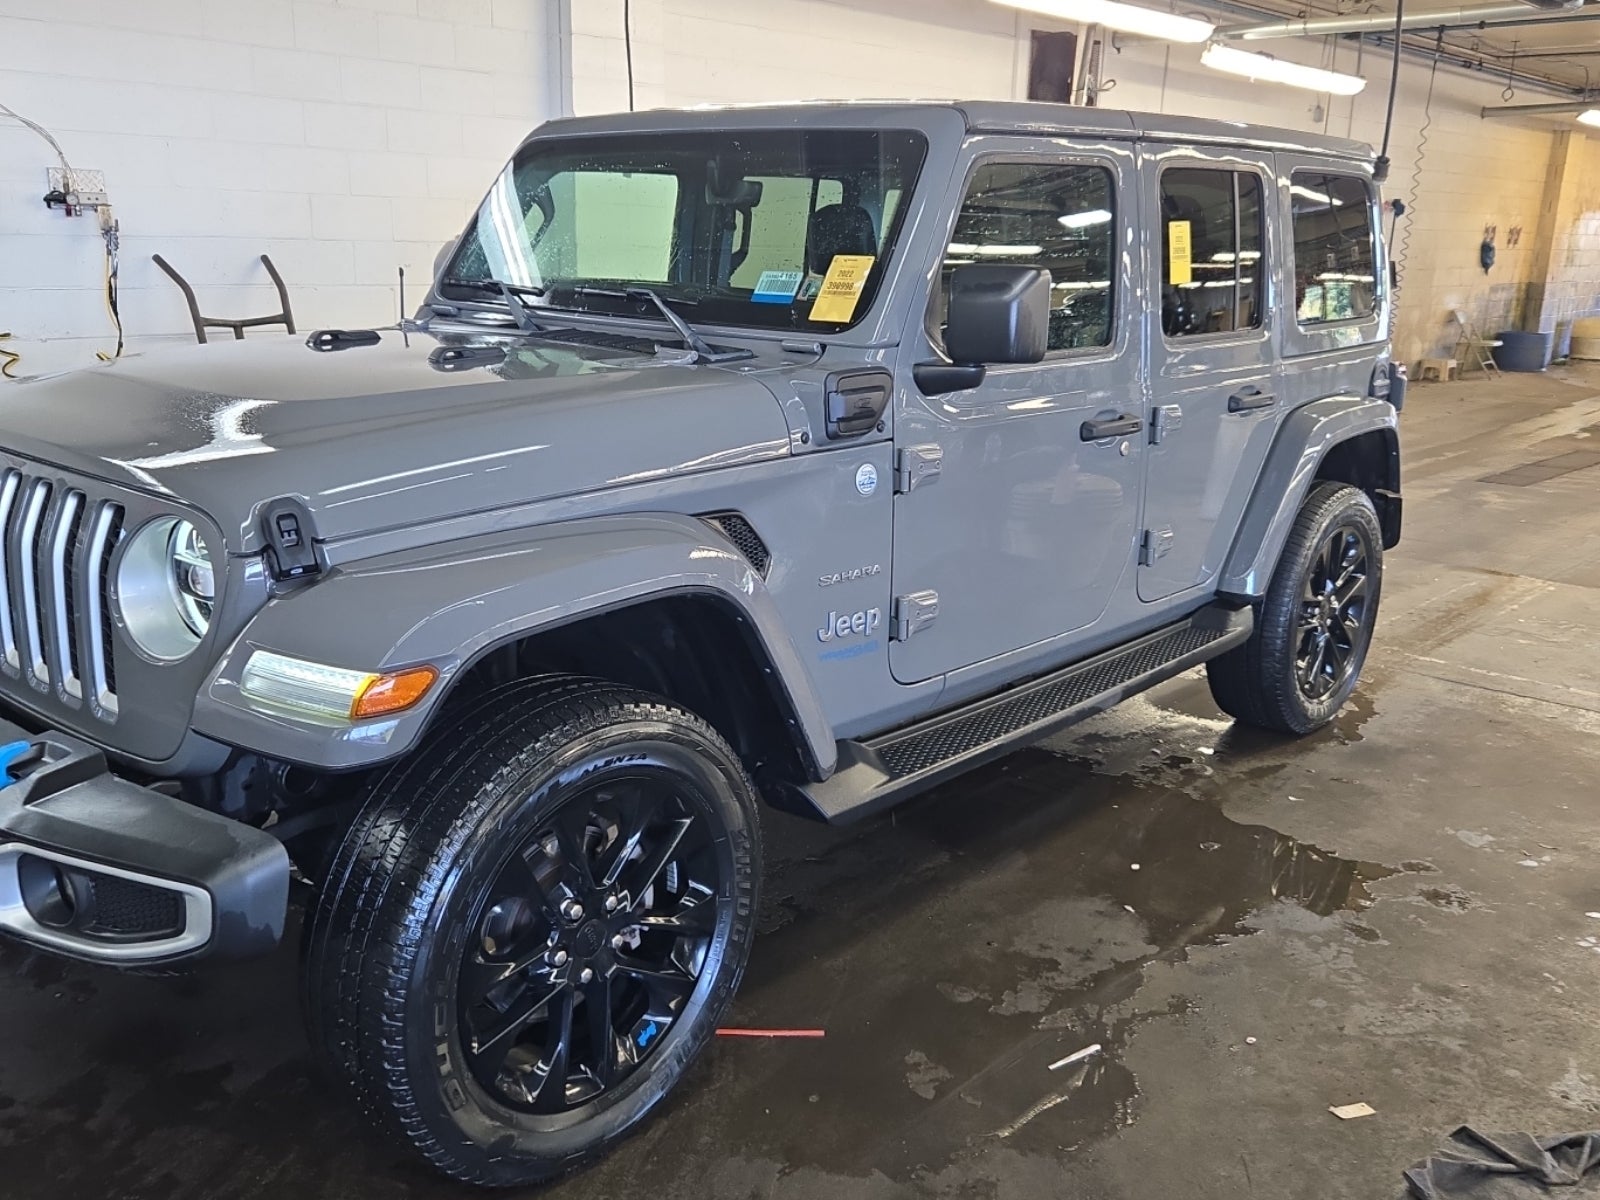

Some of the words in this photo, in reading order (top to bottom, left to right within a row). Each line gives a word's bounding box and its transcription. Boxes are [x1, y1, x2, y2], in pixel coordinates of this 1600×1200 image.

[837, 270, 854, 278] 2022
[818, 564, 881, 587] SAHARA
[817, 607, 881, 642] Jeep
